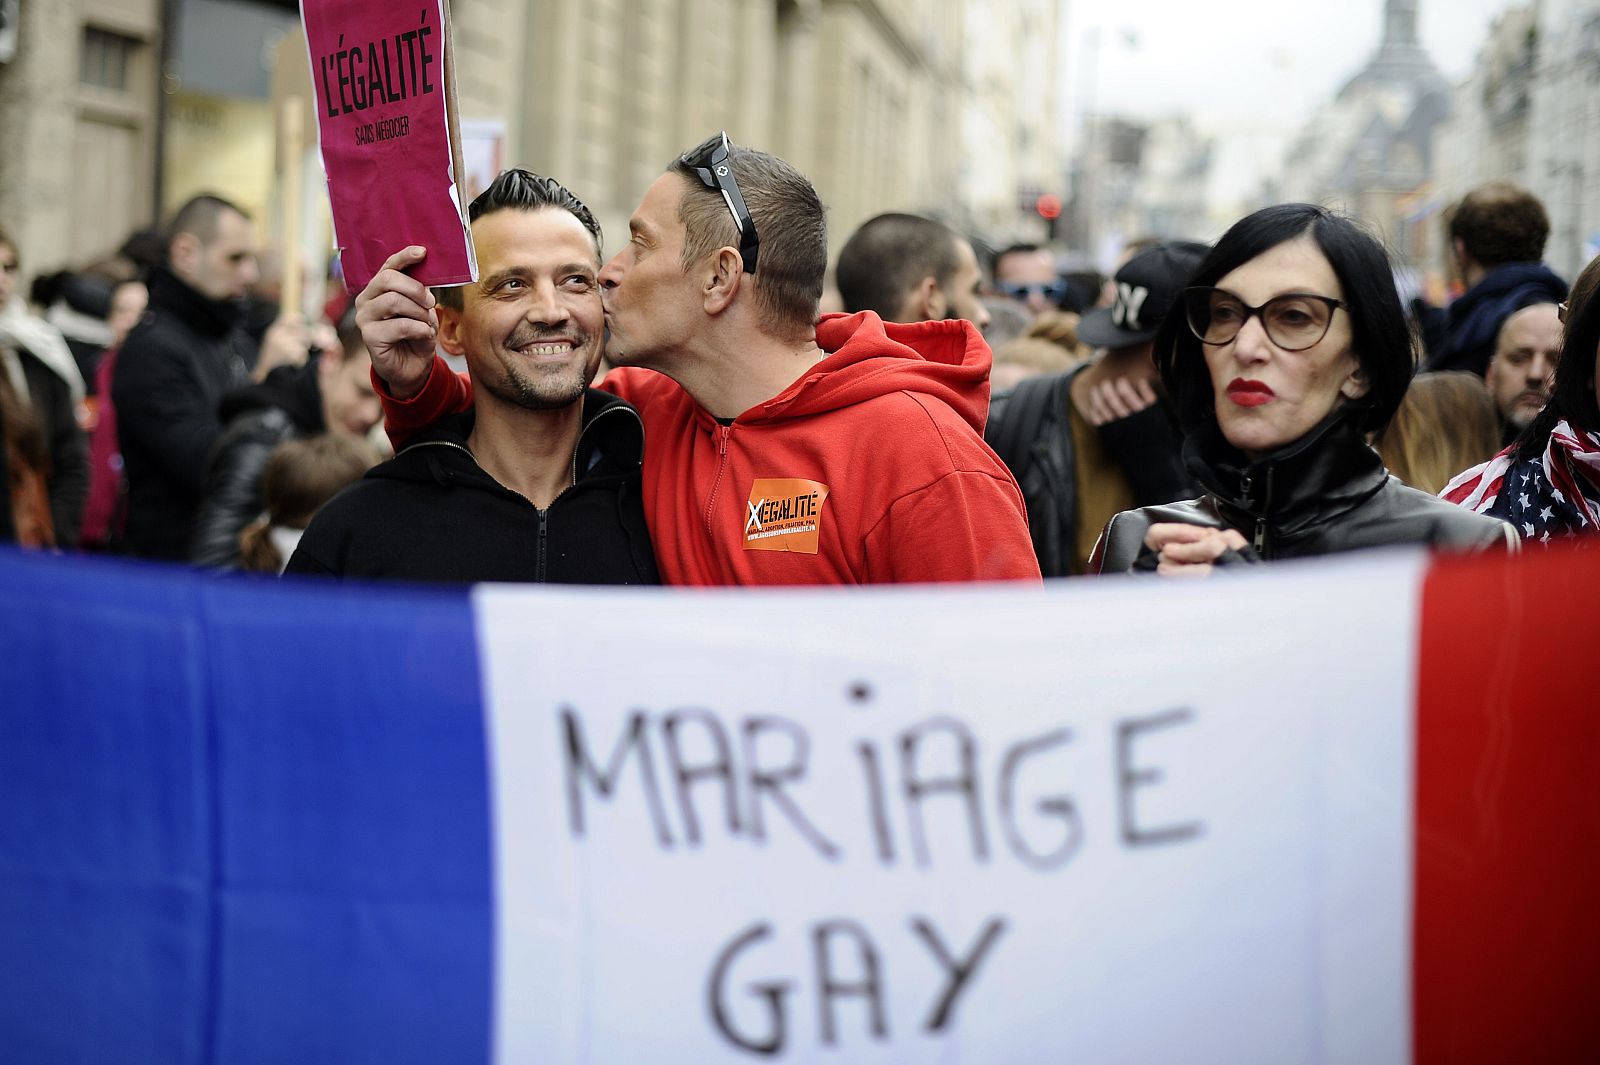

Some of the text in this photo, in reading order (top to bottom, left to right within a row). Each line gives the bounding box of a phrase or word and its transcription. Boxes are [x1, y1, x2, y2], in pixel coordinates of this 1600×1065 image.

[321, 9, 434, 118] L'ÉGALITÉ
[355, 115, 410, 146] SANS NÉGOCIER
[707, 915, 1008, 1058] GAY
